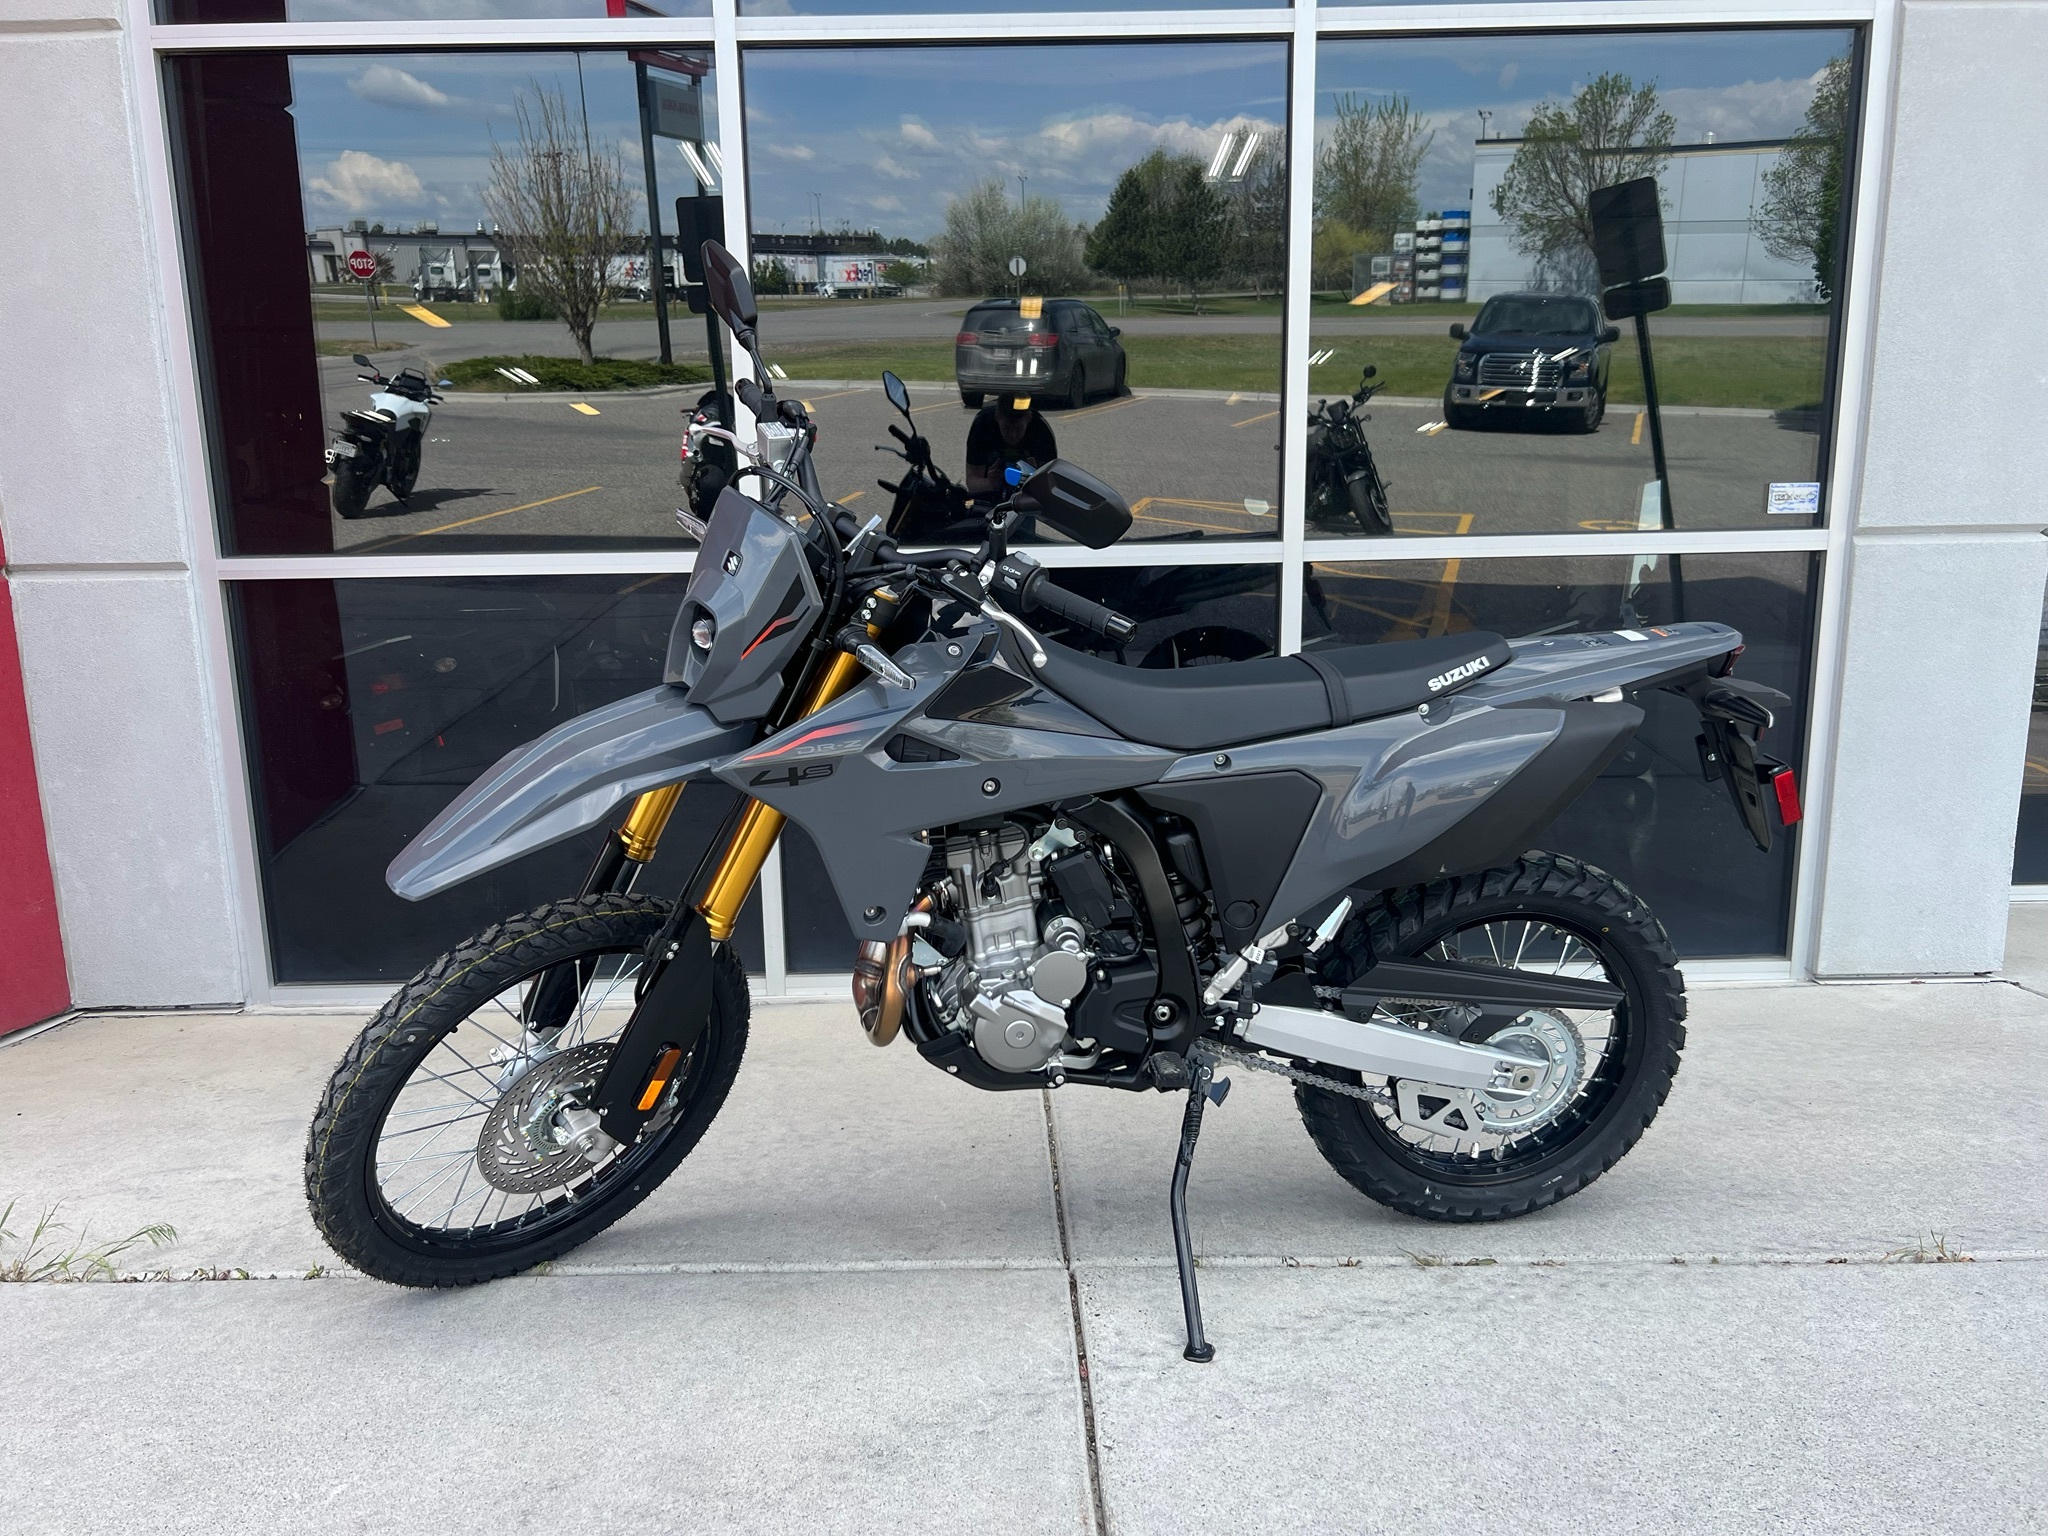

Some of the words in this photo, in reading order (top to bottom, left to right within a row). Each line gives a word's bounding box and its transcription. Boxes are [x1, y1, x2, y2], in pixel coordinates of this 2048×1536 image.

[1427, 655, 1491, 692] SUZUKI
[797, 739, 862, 755] DR-Z
[749, 763, 833, 787] 4S
